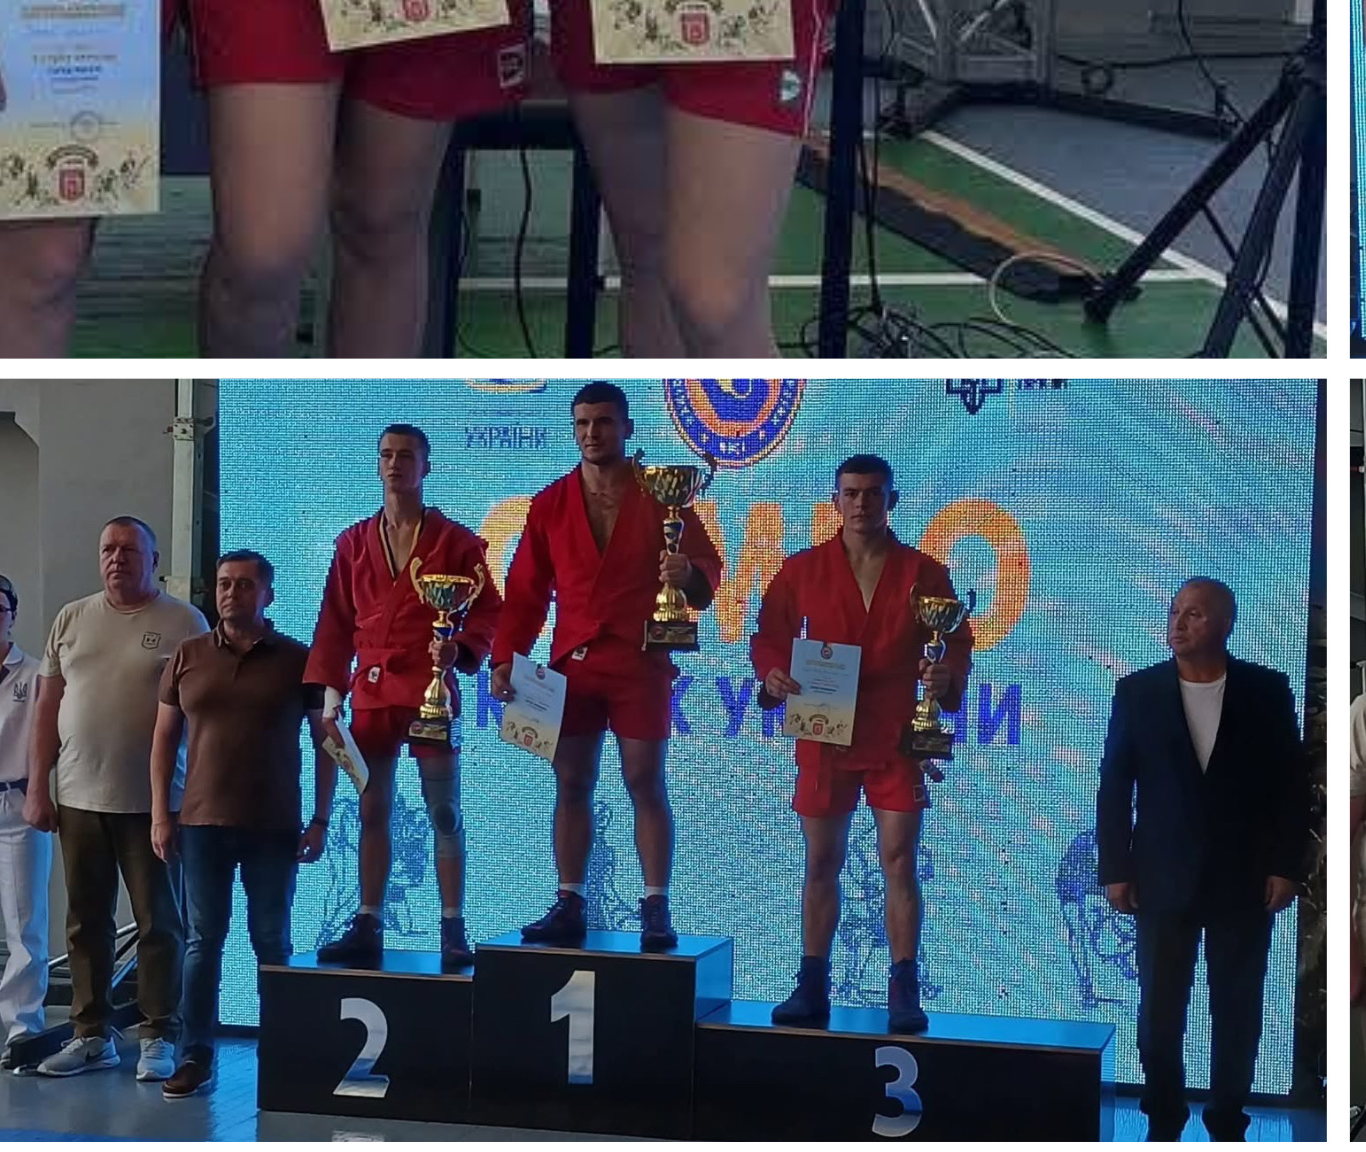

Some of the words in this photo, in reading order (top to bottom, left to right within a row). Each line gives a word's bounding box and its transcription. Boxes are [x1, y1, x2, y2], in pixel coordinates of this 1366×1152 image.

[333, 997, 391, 1099] 2
[550, 970, 597, 1085] 1
[871, 1046, 923, 1138] 3
